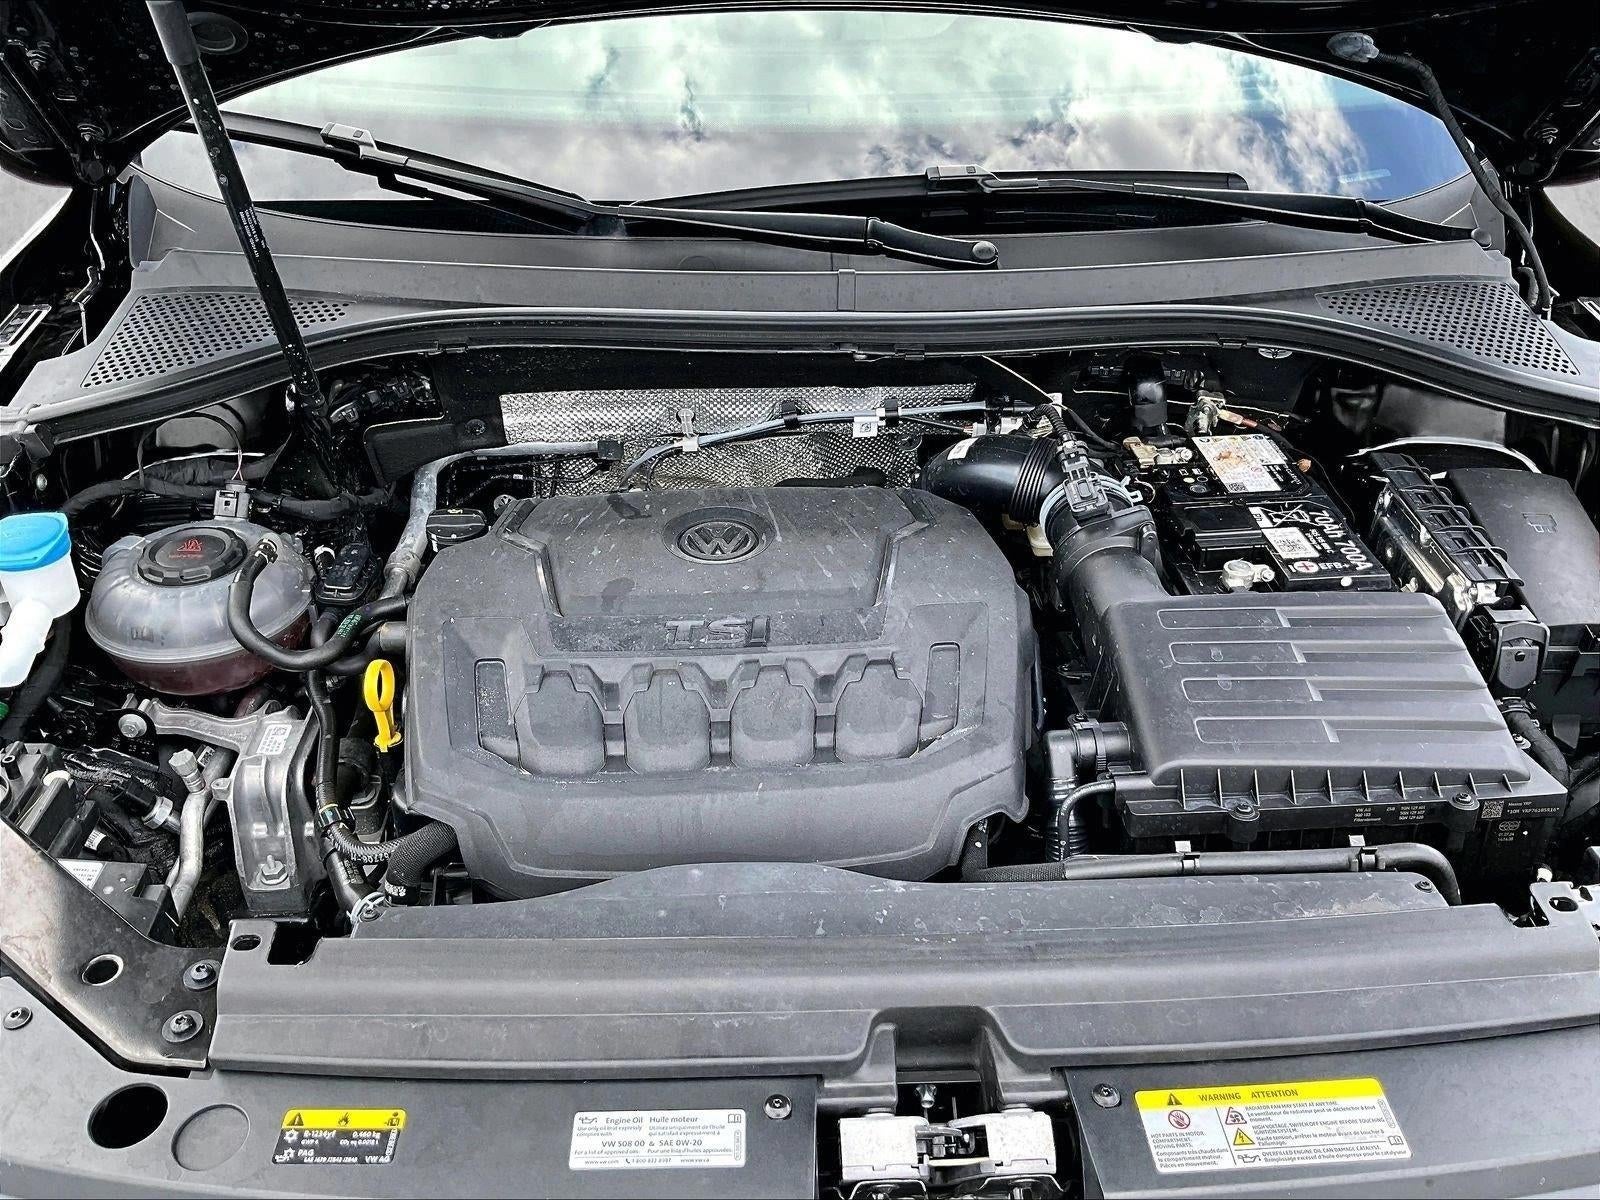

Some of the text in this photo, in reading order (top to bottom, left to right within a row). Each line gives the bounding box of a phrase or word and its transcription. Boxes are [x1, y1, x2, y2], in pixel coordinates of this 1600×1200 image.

[1309, 510, 1346, 538] 70Ah
[1334, 540, 1373, 571] 700A
[664, 615, 771, 649] TSI
[1199, 1089, 1298, 1102] WARNING ATTENTION
[606, 1117, 631, 1125] Engine
[304, 1130, 336, 1140] R-1234yf
[602, 1140, 616, 1148] VW
[365, 1155, 379, 1163] VW
